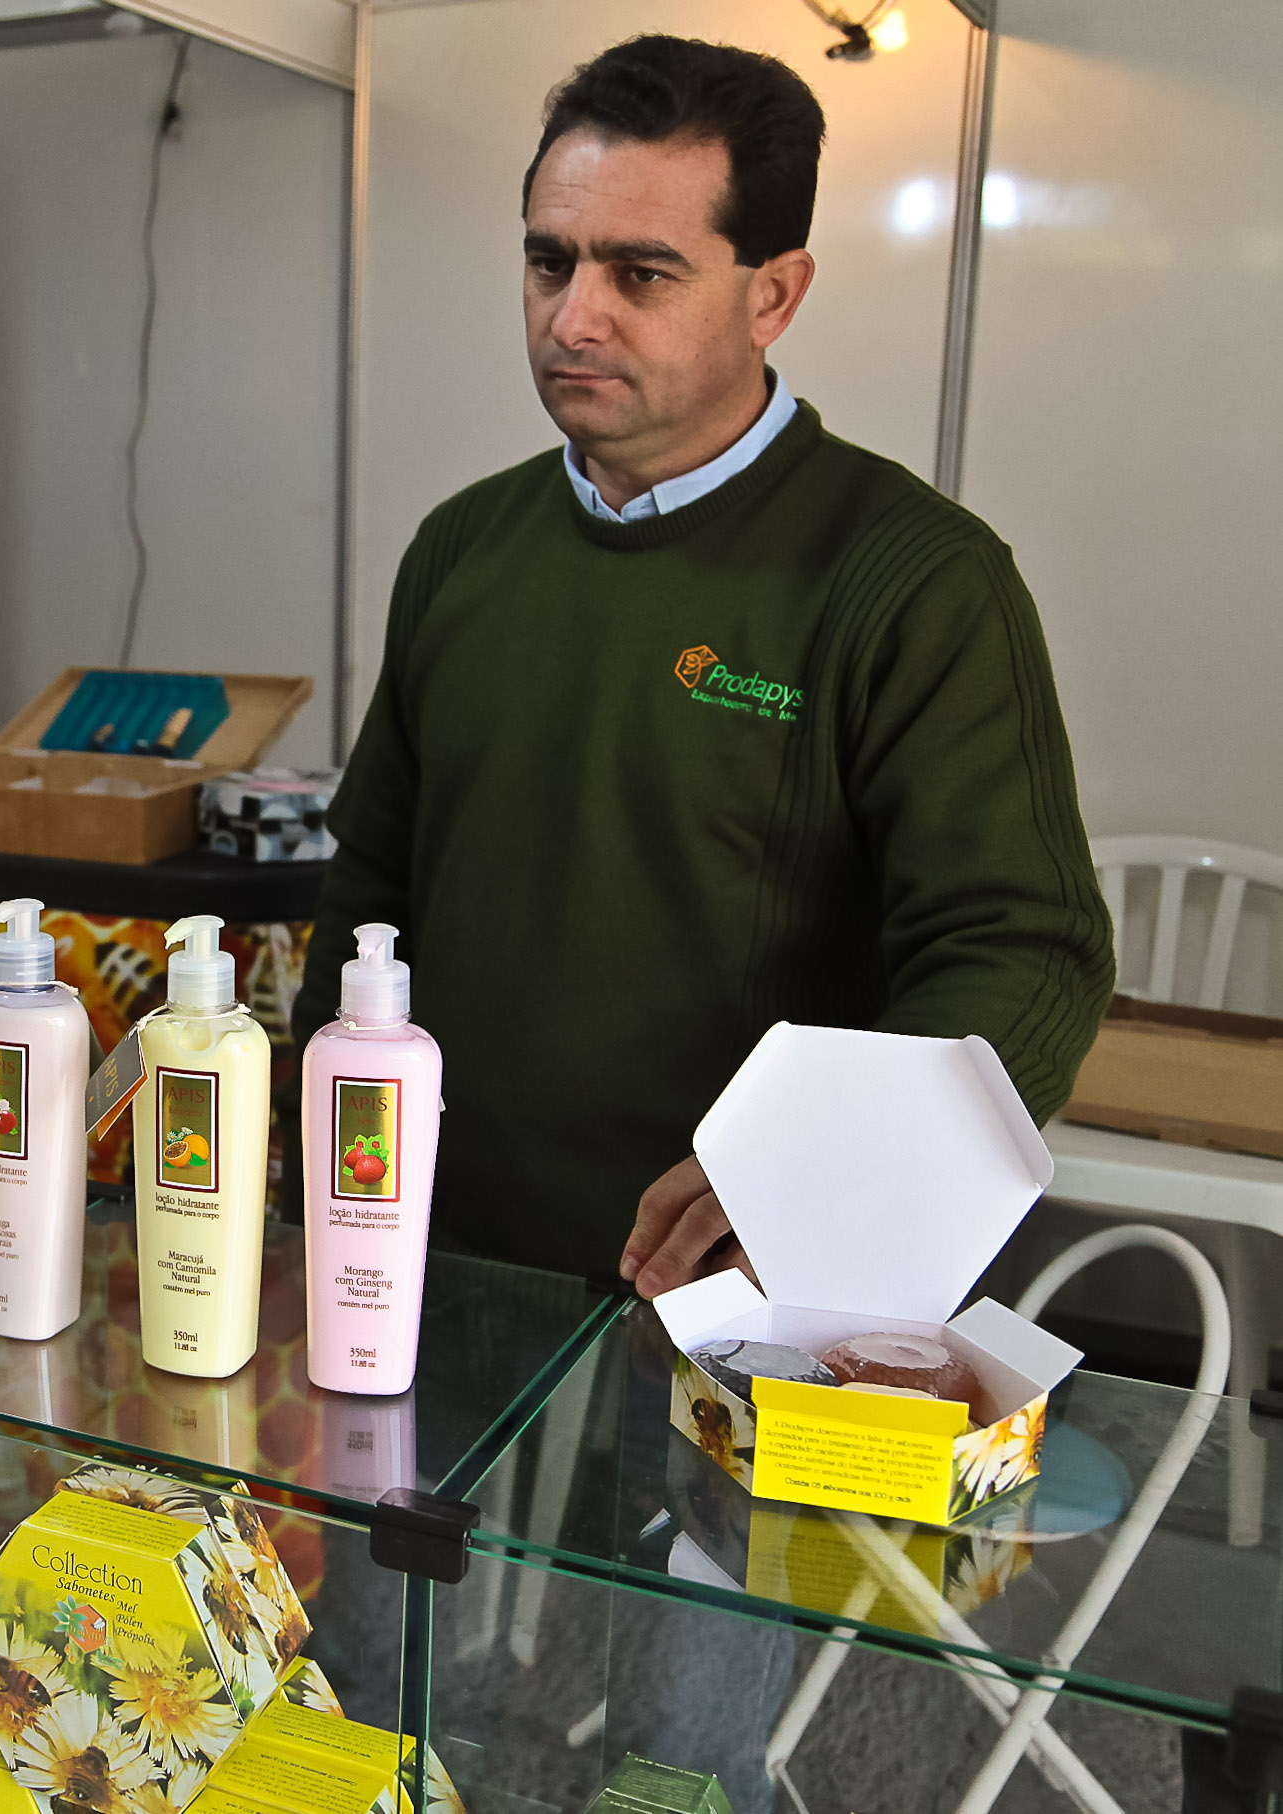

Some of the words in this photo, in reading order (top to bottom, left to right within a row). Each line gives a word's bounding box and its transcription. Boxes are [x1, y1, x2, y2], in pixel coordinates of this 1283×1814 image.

[706, 664, 804, 710] Prodapys
[104, 1057, 119, 1098] APIS
[168, 1087, 205, 1104] APIS
[347, 1095, 388, 1112] APIS
[156, 1192, 175, 1206] loção
[178, 1197, 219, 1210] hidratante
[202, 1212, 219, 1220] corpo
[329, 1206, 352, 1220] loção
[355, 1209, 400, 1220] hidratante
[362, 1222, 375, 1230] para
[168, 1250, 204, 1265] Maracujá
[158, 1260, 173, 1270] com
[175, 1263, 216, 1275] Camomila
[344, 1265, 383, 1279] Morango
[171, 1271, 200, 1284] Natural
[335, 1277, 354, 1285] com
[356, 1278, 393, 1290] Ginseng
[163, 1284, 183, 1292] contém
[347, 1287, 379, 1298] Natural
[337, 1300, 360, 1308] contém
[174, 1330, 198, 1342] 350ml
[350, 1348, 376, 1358] 350ml
[31, 1543, 144, 1596] Collection
[55, 1575, 117, 1603] Sabonetes
[116, 1600, 139, 1614] Mel
[116, 1613, 143, 1629] Pólen
[115, 1626, 156, 1647] Própolis
